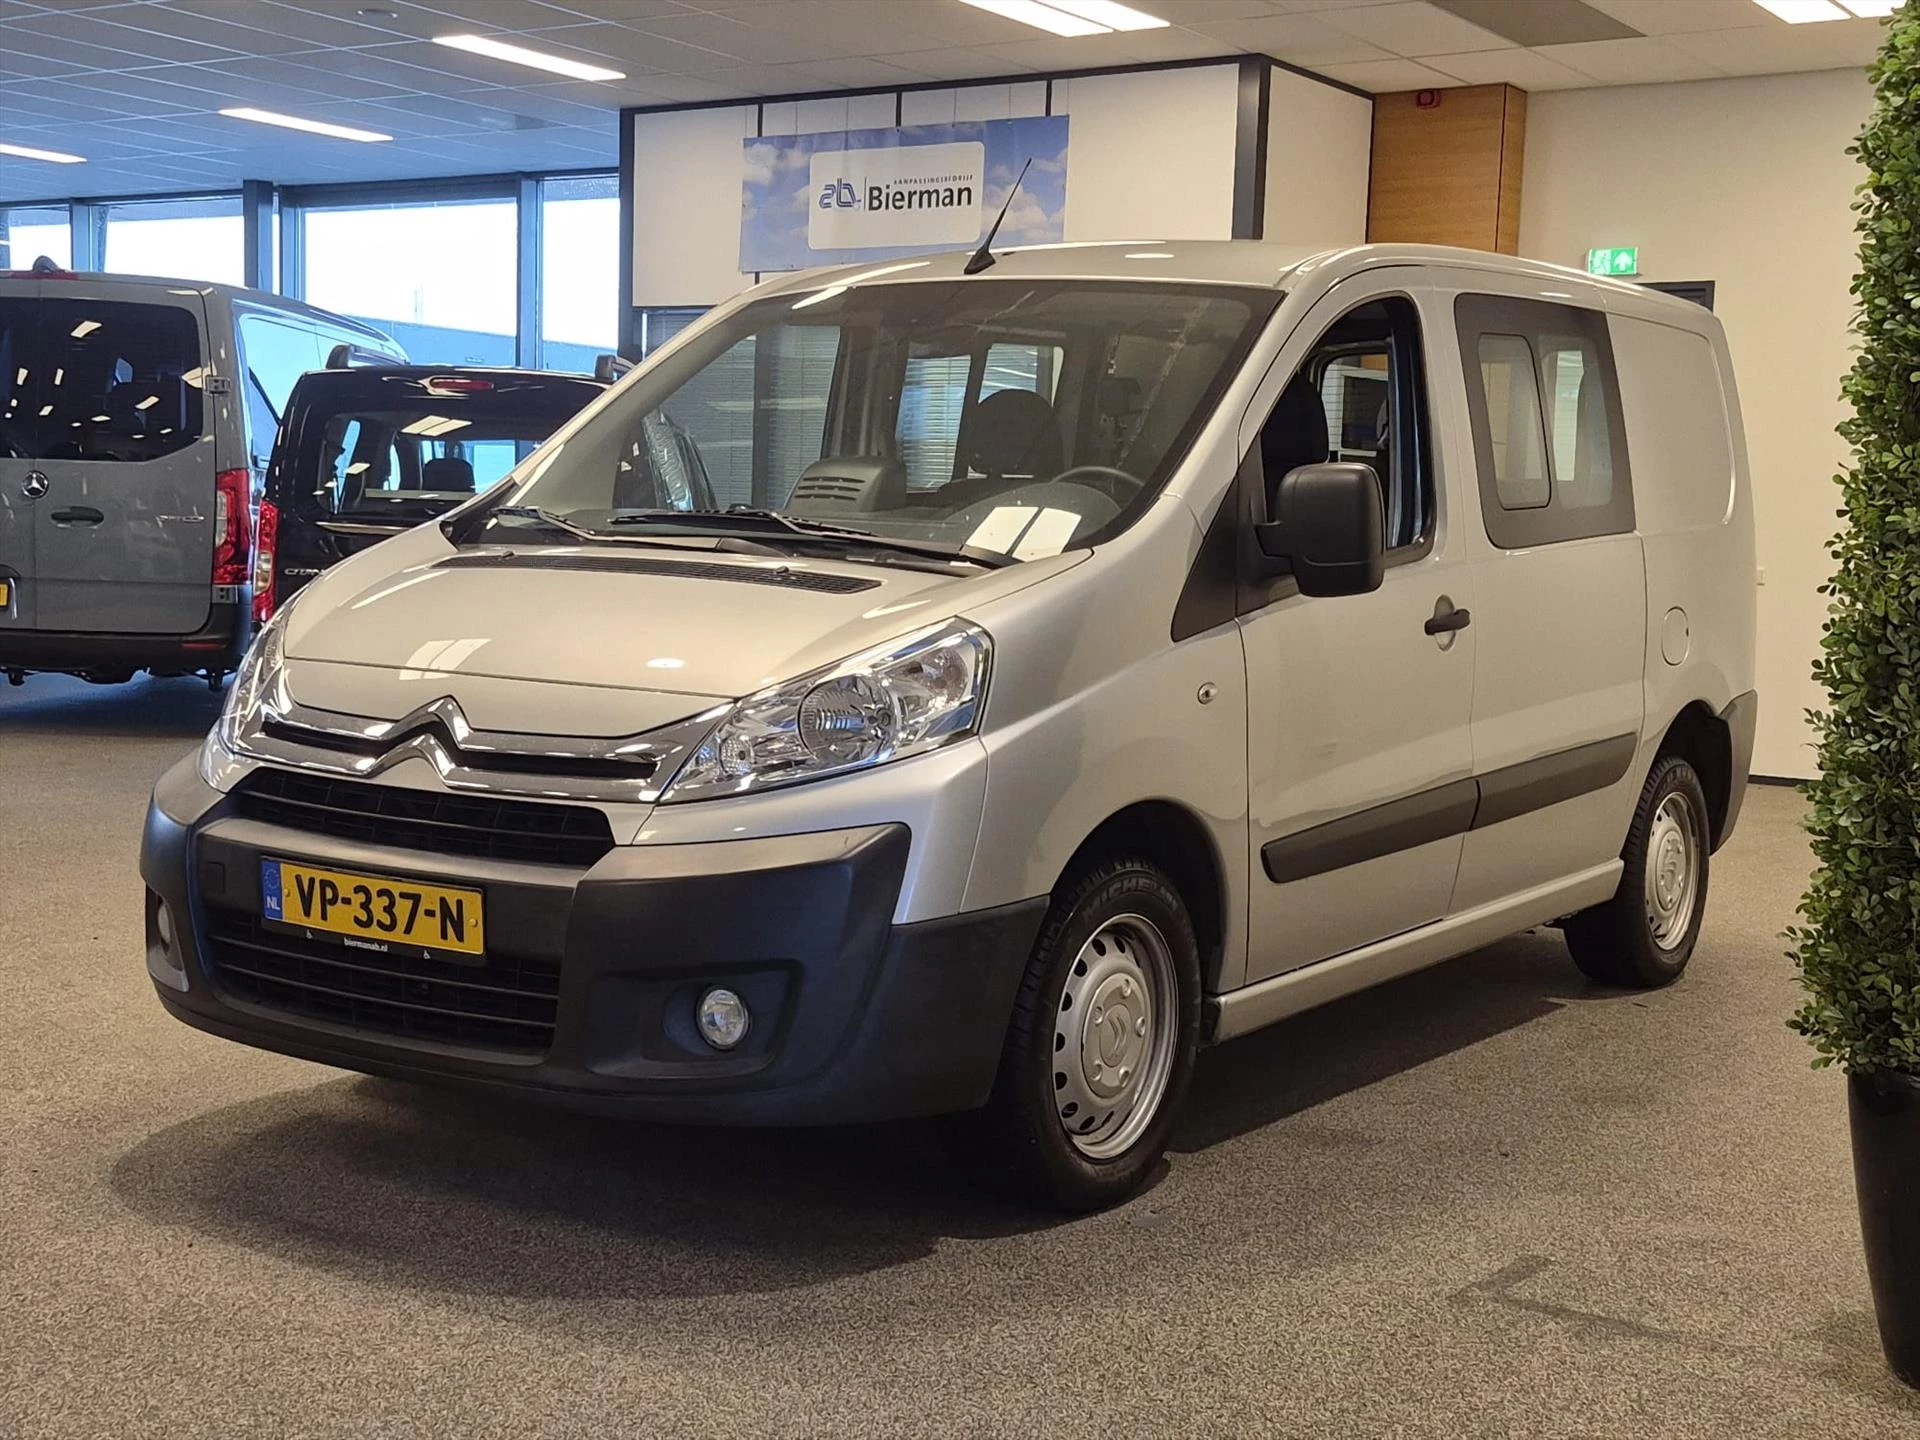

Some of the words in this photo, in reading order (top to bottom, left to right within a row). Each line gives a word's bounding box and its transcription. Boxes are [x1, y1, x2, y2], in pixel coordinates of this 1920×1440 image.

[868, 184, 973, 211] Bierman
[266, 896, 281, 911] NL
[294, 873, 465, 943] VP-337-N
